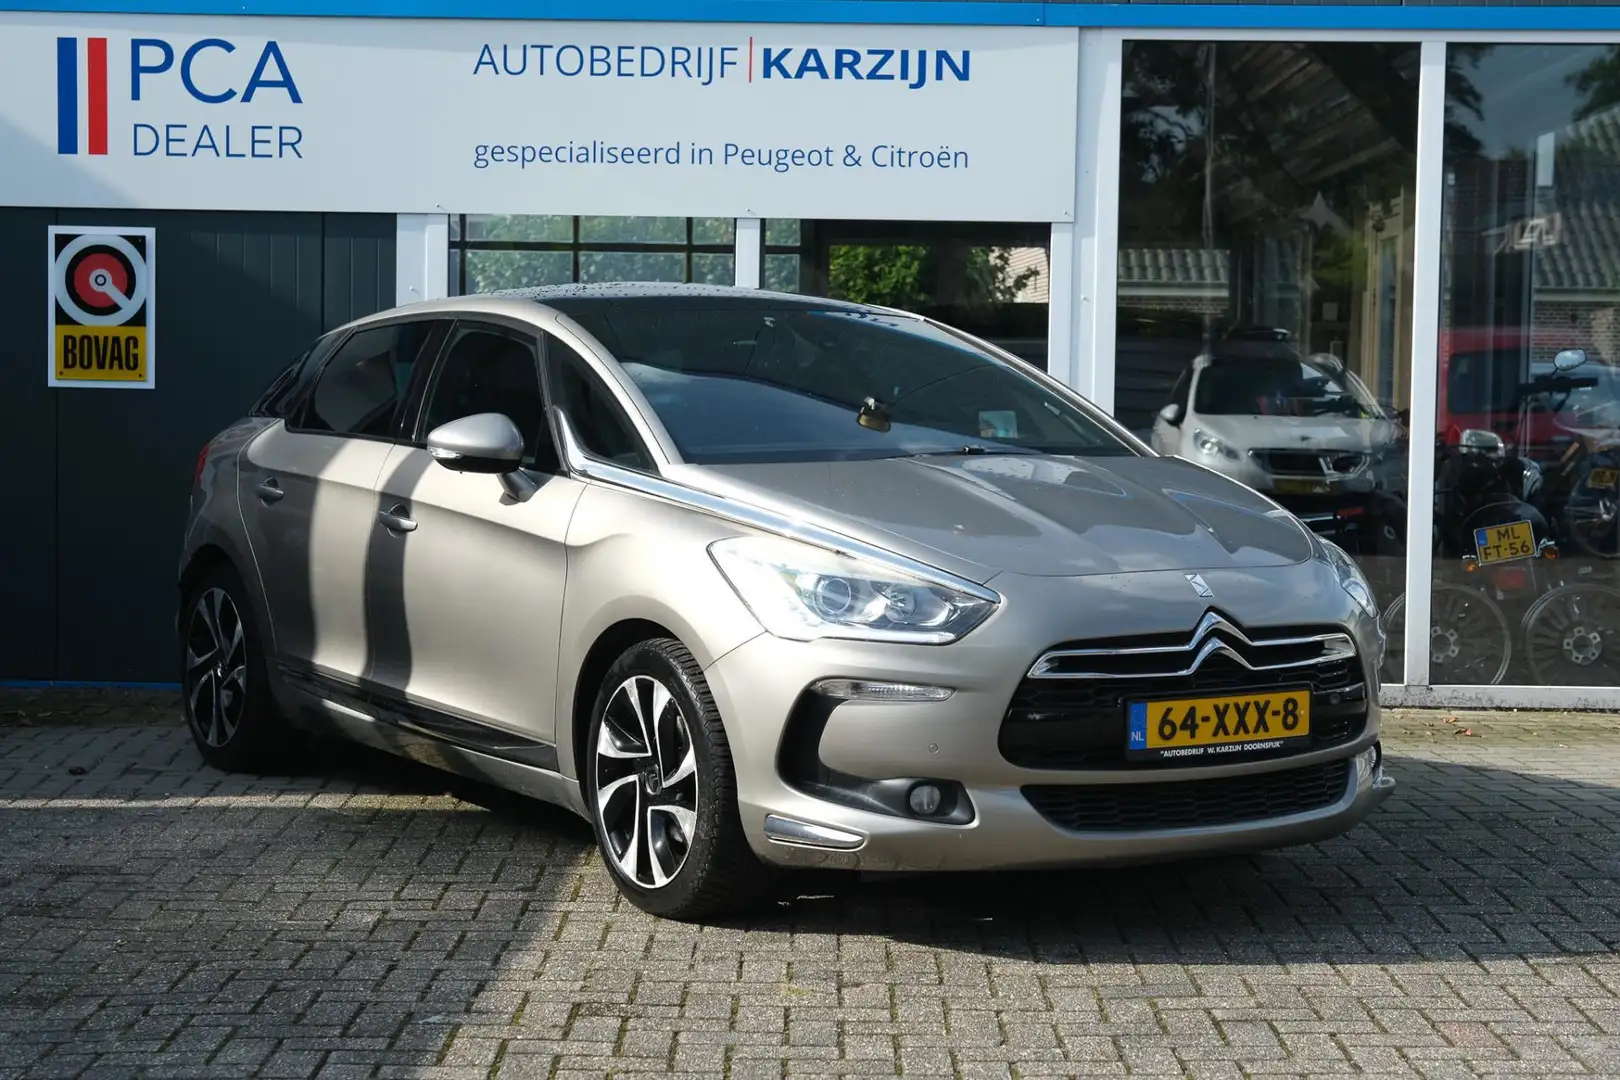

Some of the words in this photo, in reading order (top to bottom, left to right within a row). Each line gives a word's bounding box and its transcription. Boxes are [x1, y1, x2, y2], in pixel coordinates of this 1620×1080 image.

[131, 38, 302, 104] PCA
[473, 43, 738, 86] AUTOBEDRIJF
[762, 47, 971, 89] KARZIJN
[132, 123, 303, 159] DEALER
[474, 140, 681, 170] gespecialiseerd
[690, 142, 715, 166] in
[723, 143, 834, 174] Peugeot
[843, 145, 863, 168] &
[872, 145, 969, 169] Citroën
[63, 334, 139, 371] BOVAG
[1483, 540, 1530, 560] FT-56
[1497, 527, 1520, 541] ML
[1131, 731, 1145, 742] NL
[1158, 698, 1299, 741] 64-XXX-8
